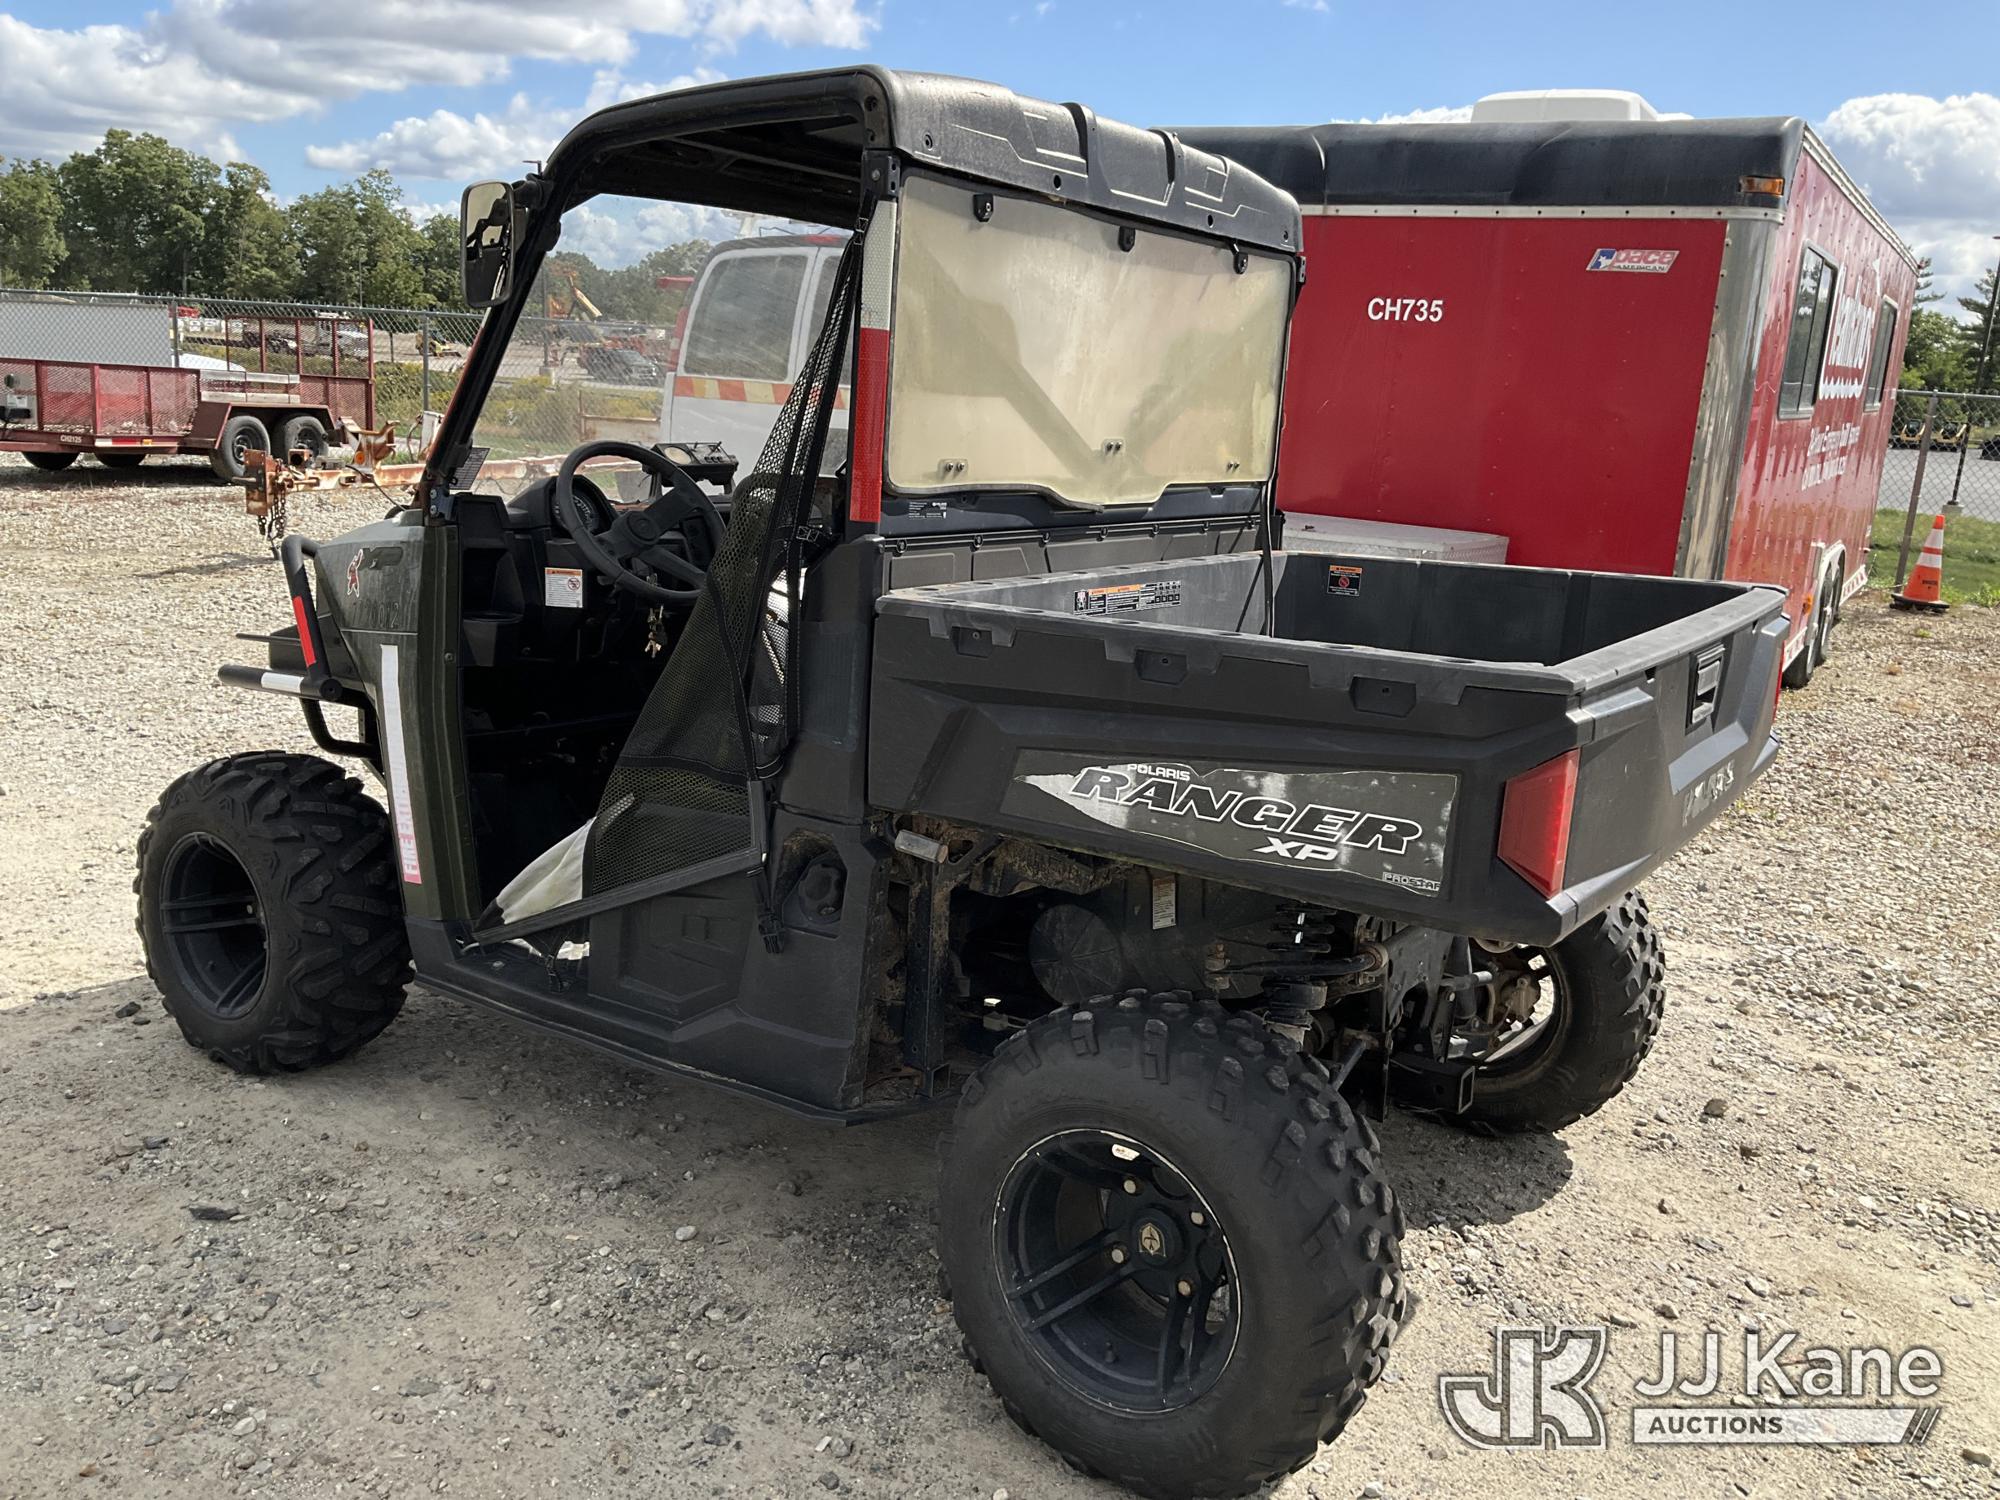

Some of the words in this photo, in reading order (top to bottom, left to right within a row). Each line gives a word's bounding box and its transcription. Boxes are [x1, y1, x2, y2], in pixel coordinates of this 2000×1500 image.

[1367, 297, 1444, 322] CH735
[1126, 763, 1191, 782] POLARIS
[1068, 767, 1423, 856] RANGER
[1252, 836, 1339, 862] XP
